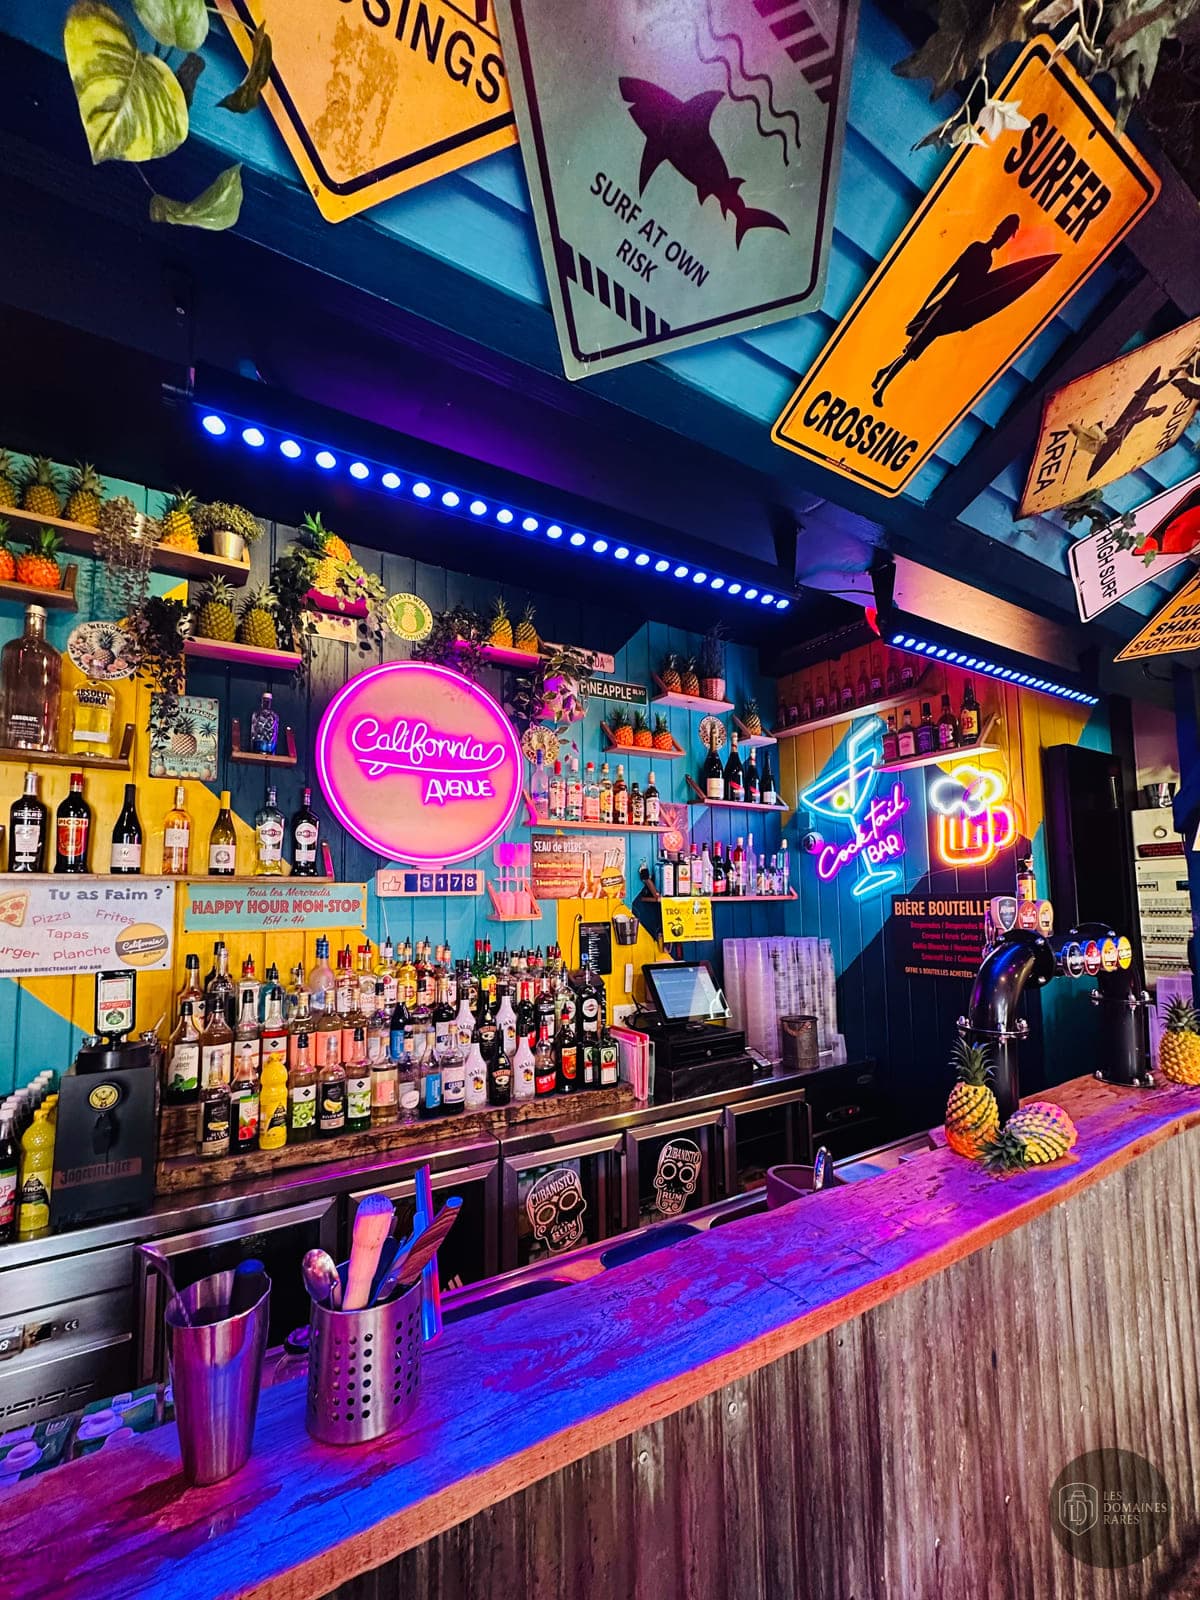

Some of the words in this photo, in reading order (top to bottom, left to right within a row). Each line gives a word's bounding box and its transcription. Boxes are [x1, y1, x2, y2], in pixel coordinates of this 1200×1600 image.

[338, 0, 505, 103] SINGS
[1004, 113, 1112, 244] SURFER
[590, 172, 642, 224] SURF
[638, 219, 668, 248] AT
[665, 241, 710, 287] OWN
[616, 238, 658, 283] RISK
[803, 391, 918, 472] CROSSING
[1033, 430, 1069, 495] AREA
[1096, 534, 1115, 568] HIGH
[1099, 564, 1117, 598] SURF
[77, 688, 111, 699] ABSOLUT
[580, 679, 632, 700] PINEAPPLE
[78, 696, 107, 706] VODKA
[351, 718, 505, 765] California
[423, 779, 493, 804] AVENUE
[533, 840, 552, 852] SEAU
[552, 841, 562, 852] de
[867, 834, 900, 863] BAR
[49, 888, 70, 900] Tu
[77, 890, 98, 900] as
[105, 887, 148, 900] Faim
[154, 888, 163, 900] ?
[246, 887, 267, 897] Tous
[270, 887, 283, 897] les
[286, 887, 331, 897] Mercredis
[32, 911, 71, 926] Pizza
[95, 909, 137, 925] Frites
[191, 900, 243, 915] HAPPY
[247, 900, 289, 914] HOUR
[292, 899, 361, 913] NON-STOP
[894, 898, 925, 916] BIÈRE
[46, 928, 90, 941] Tapas
[122, 938, 165, 951] California
[664, 1145, 701, 1164] CUBANISTO
[529, 1171, 576, 1208] CUBANISTO
[662, 1191, 682, 1201] RUM
[551, 1220, 577, 1242] RUM
[64, 1320, 78, 1331] CE
